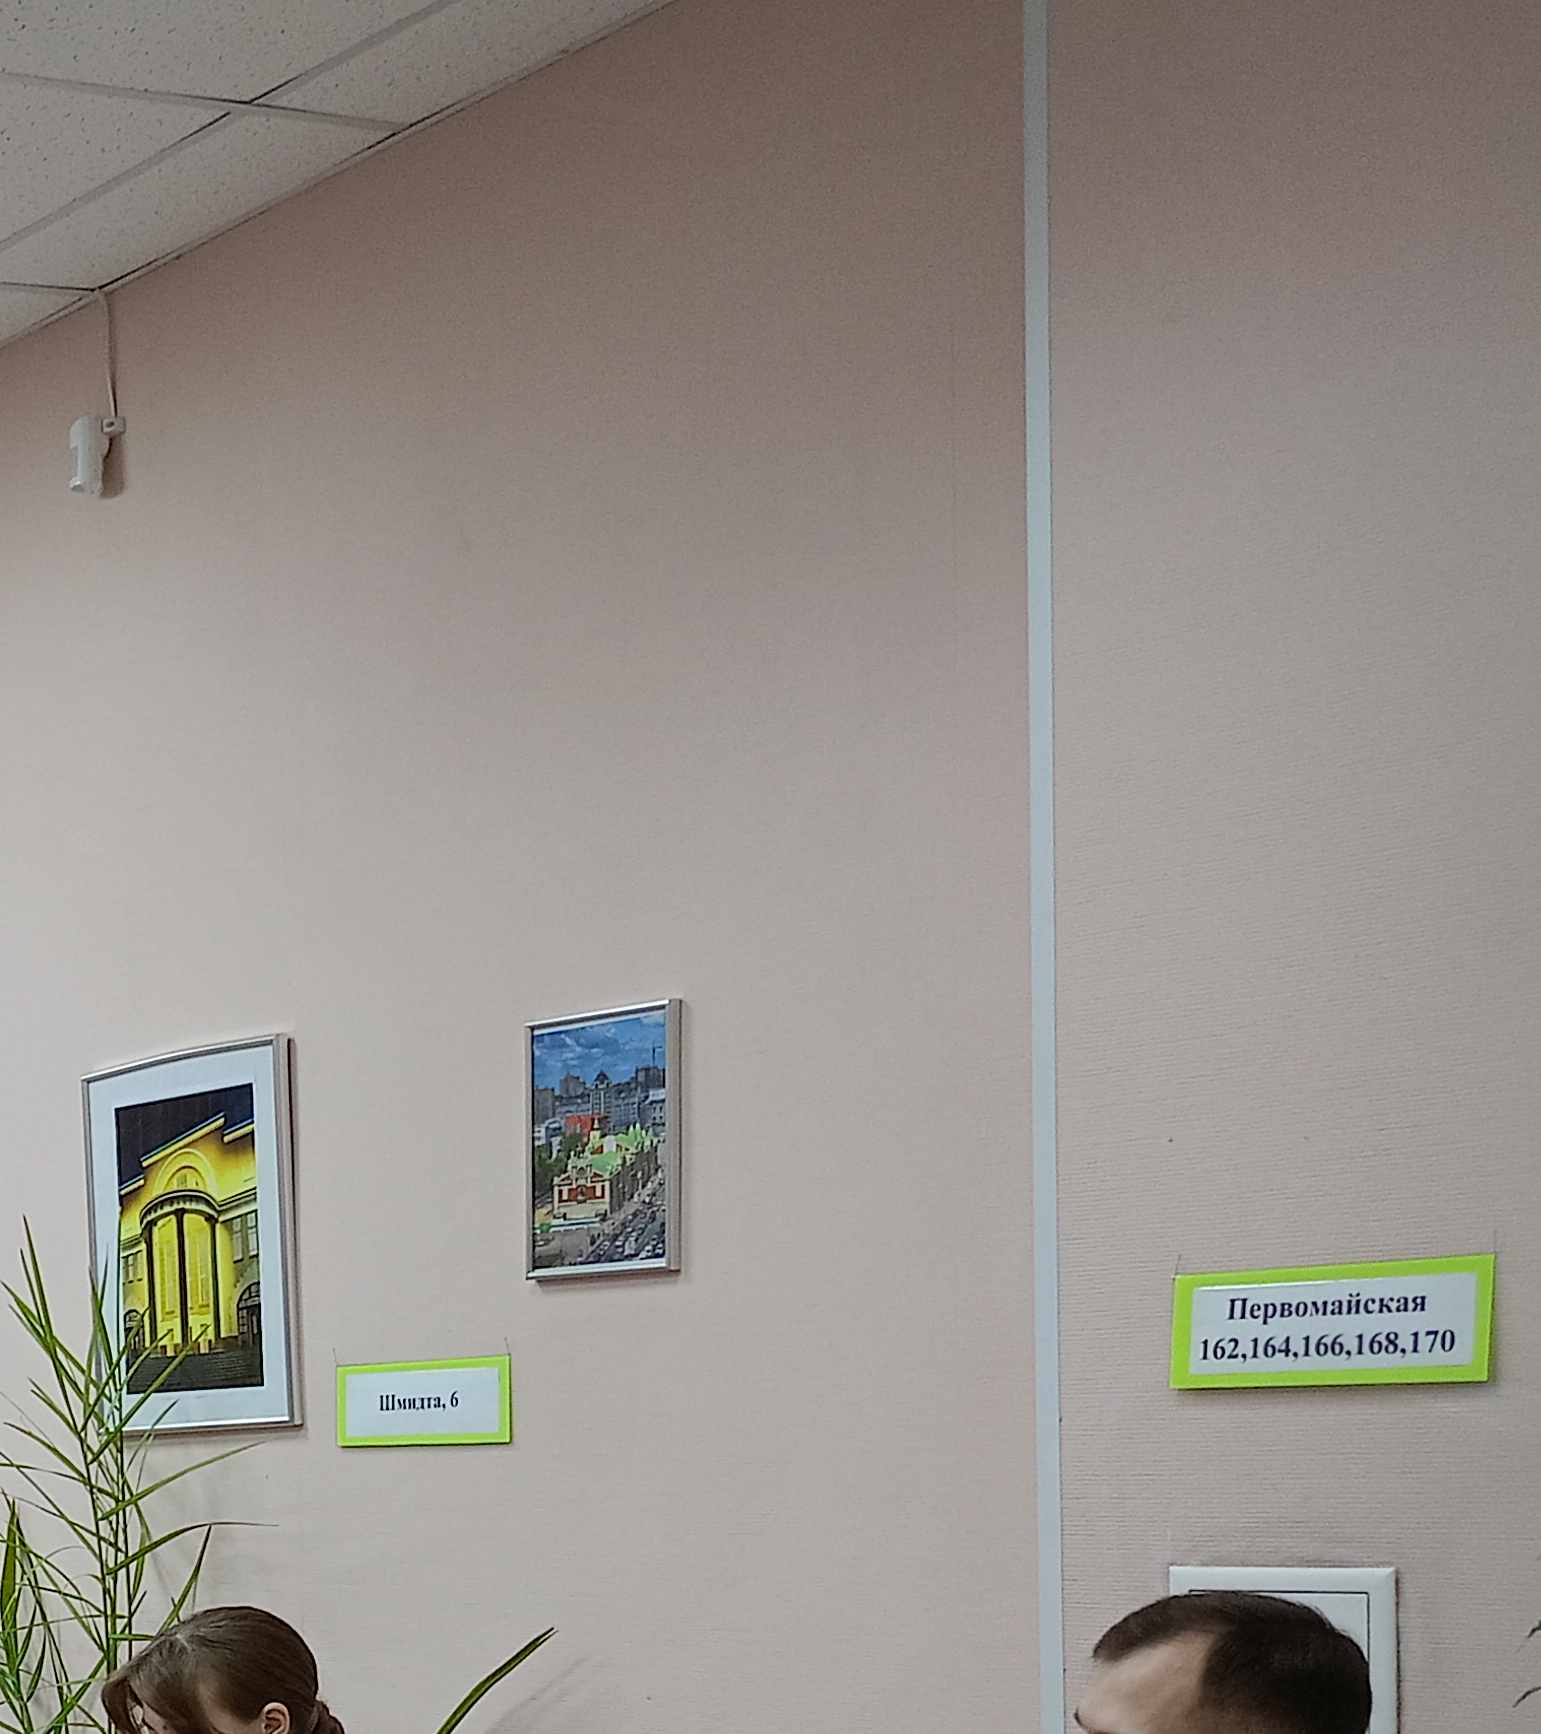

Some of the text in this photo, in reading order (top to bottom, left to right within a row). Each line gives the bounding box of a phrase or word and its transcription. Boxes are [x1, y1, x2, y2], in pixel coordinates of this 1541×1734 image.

[1227, 1292, 1427, 1325] Первомайская
[379, 1390, 459, 1412] Шмидта, 6
